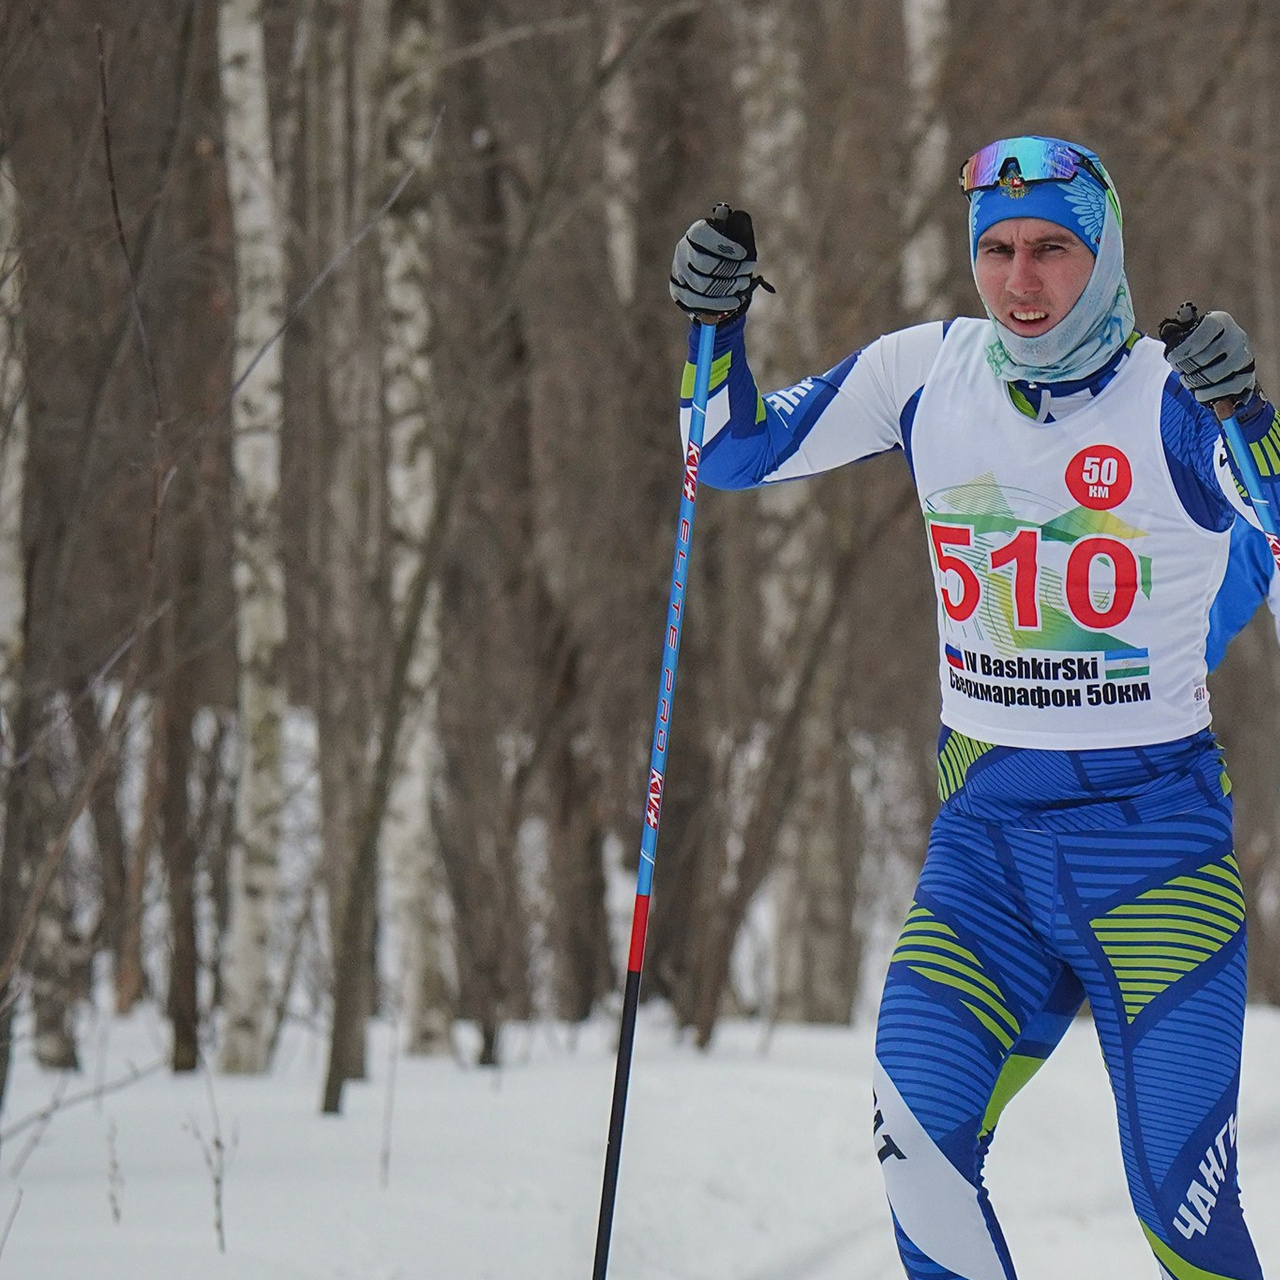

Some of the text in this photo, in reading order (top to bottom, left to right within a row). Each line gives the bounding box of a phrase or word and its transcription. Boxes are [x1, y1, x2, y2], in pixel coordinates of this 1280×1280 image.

[1081, 456, 1119, 485] 50
[929, 521, 1140, 631] 510
[963, 649, 1099, 682] IV BashkirSki
